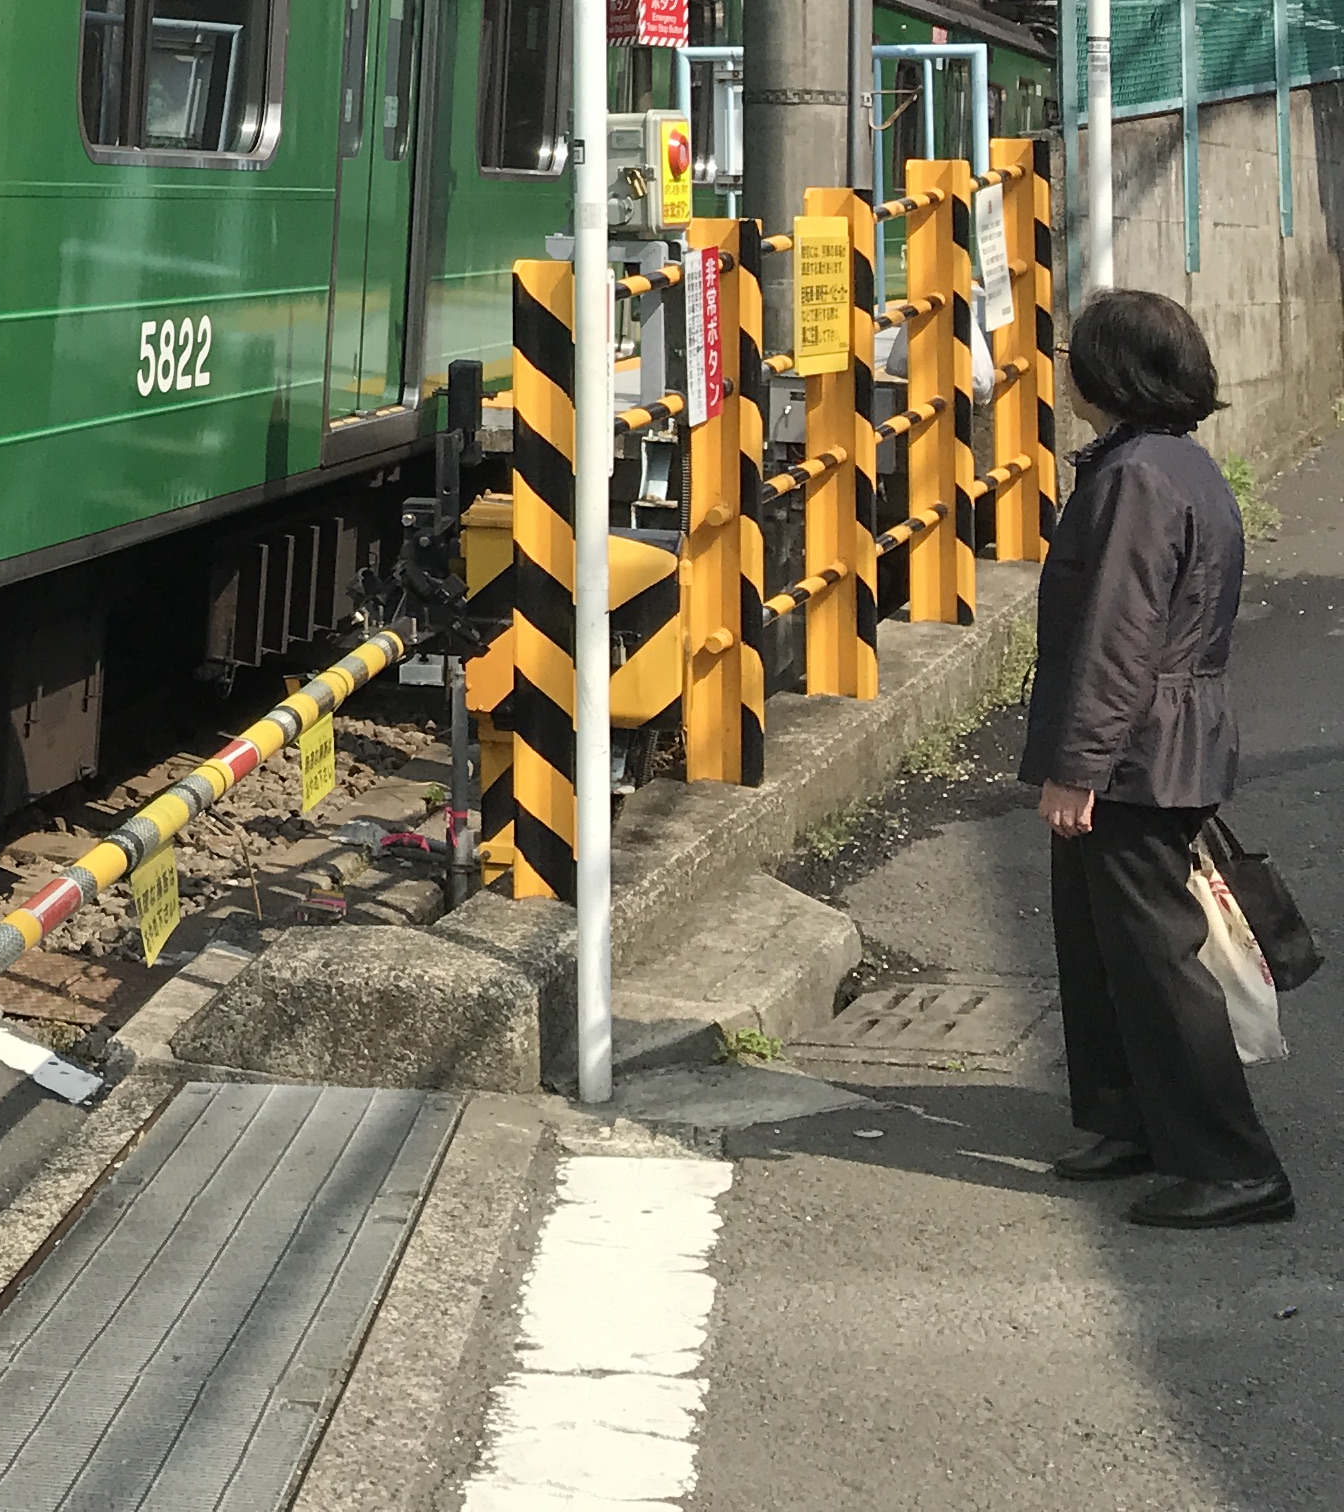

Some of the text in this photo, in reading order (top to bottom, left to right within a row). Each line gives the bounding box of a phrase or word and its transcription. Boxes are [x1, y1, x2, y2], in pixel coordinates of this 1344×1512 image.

[137, 315, 212, 396] 5822
[705, 257, 720, 407] 非常ボタン
